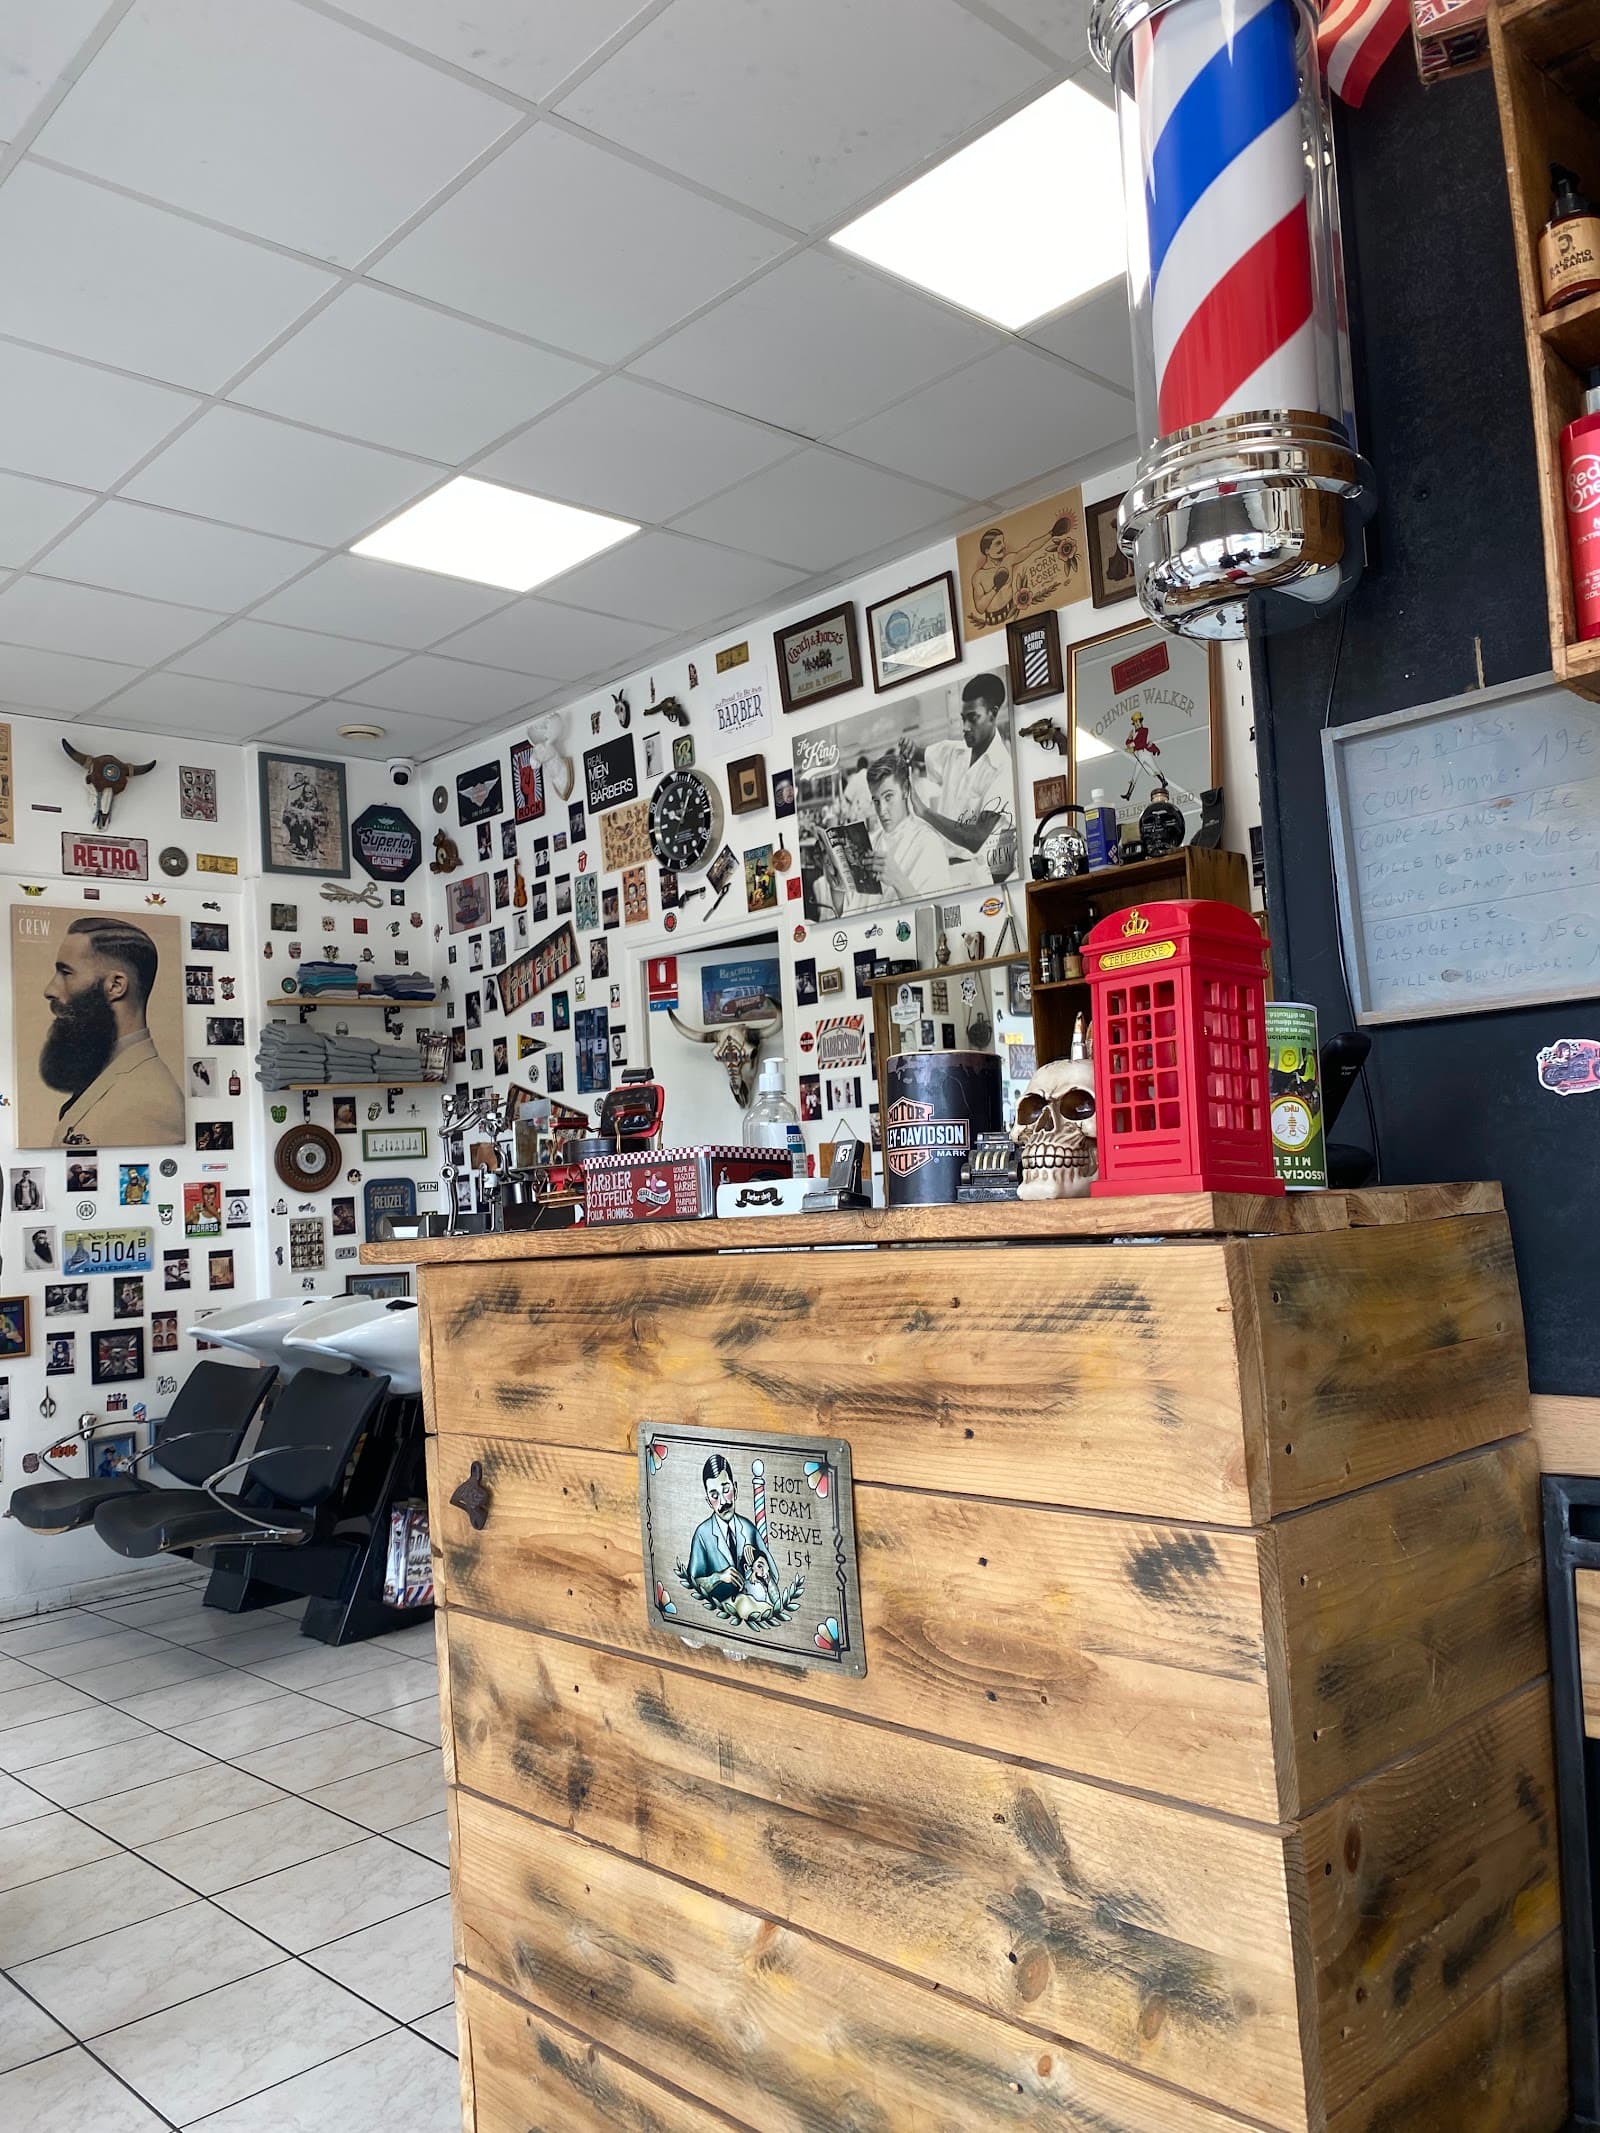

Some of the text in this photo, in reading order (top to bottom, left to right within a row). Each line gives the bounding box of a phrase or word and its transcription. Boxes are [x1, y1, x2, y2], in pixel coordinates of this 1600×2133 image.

[1029, 554, 1057, 578] BORN
[1030, 563, 1061, 587] LOSER
[1024, 630, 1046, 646] BARBER
[1026, 640, 1043, 652] SHOP
[717, 694, 763, 730] BARBER
[1143, 688, 1195, 718] WALKER
[587, 754, 604, 769] REAL
[802, 739, 840, 770] King
[588, 762, 609, 781] MEN
[589, 777, 607, 793] LOVE
[590, 778, 634, 806] BARBERS
[1362, 784, 1432, 815] COUPE
[517, 801, 543, 818] ROCK
[357, 827, 416, 852] Superior
[73, 844, 139, 871] RETRO
[19, 918, 51, 937] CREW
[1107, 946, 1165, 965] TELEPHONE
[586, 1171, 633, 1192] BARBIER
[674, 1181, 697, 1193] BARBE
[374, 1195, 404, 1209] REUZEL
[586, 1189, 634, 1208] COIFFEUR
[588, 1207, 634, 1221] POUR HOMMES
[105, 1231, 128, 1240] Jersey
[92, 1239, 136, 1264] 5104
[84, 1264, 133, 1274] BATTLESHIP
[773, 1476, 804, 1496] HOT
[769, 1497, 813, 1520] FOAM
[769, 1523, 823, 1546] SHAVE
